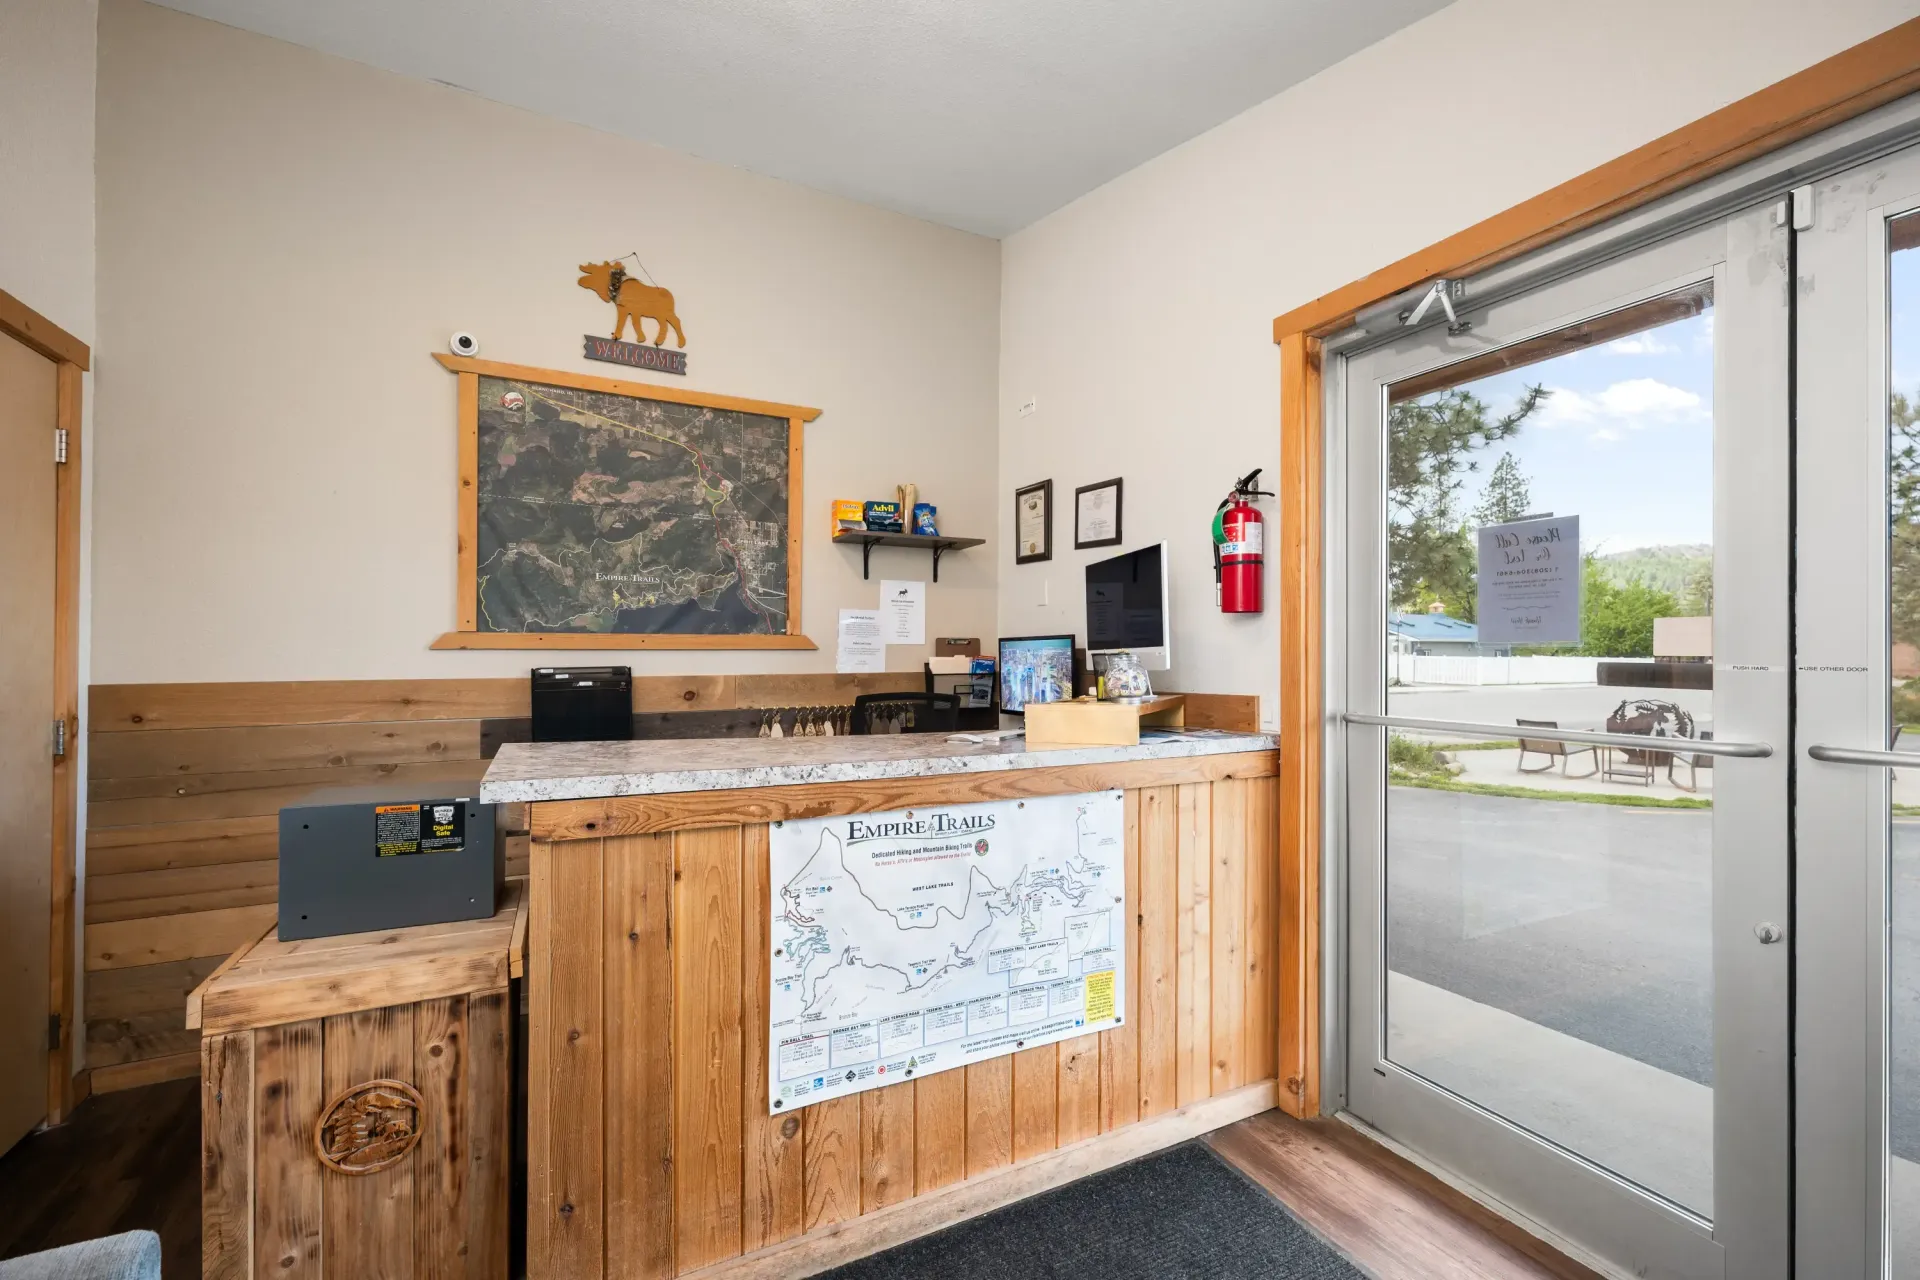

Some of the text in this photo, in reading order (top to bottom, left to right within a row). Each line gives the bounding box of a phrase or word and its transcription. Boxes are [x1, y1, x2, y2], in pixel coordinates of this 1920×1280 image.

[594, 340, 681, 370] WELCOME
[872, 504, 894, 512] Advil
[596, 572, 660, 583] EMPIRE TRAILS
[847, 813, 996, 840] EMPIRE TRAILS
[897, 849, 911, 857] Hiking
